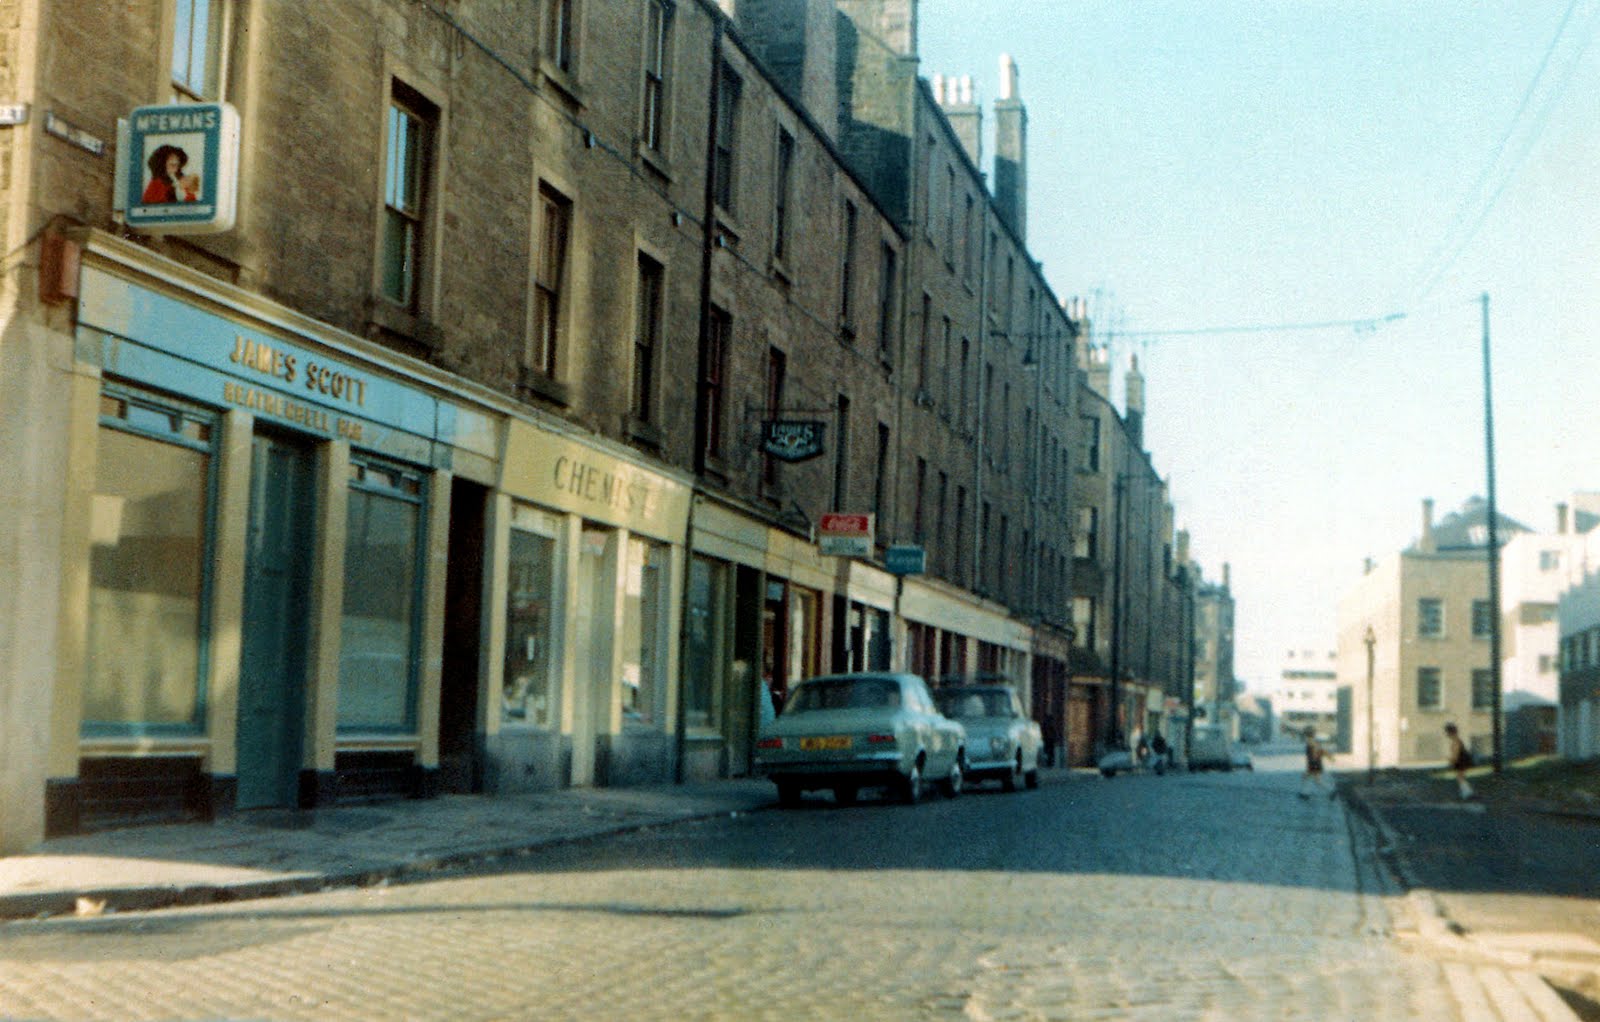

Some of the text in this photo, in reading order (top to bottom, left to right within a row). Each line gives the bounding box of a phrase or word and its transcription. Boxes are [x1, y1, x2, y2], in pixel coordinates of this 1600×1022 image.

[230, 335, 367, 406] JAMES SCOTT
[554, 455, 651, 517] CHEMIST
